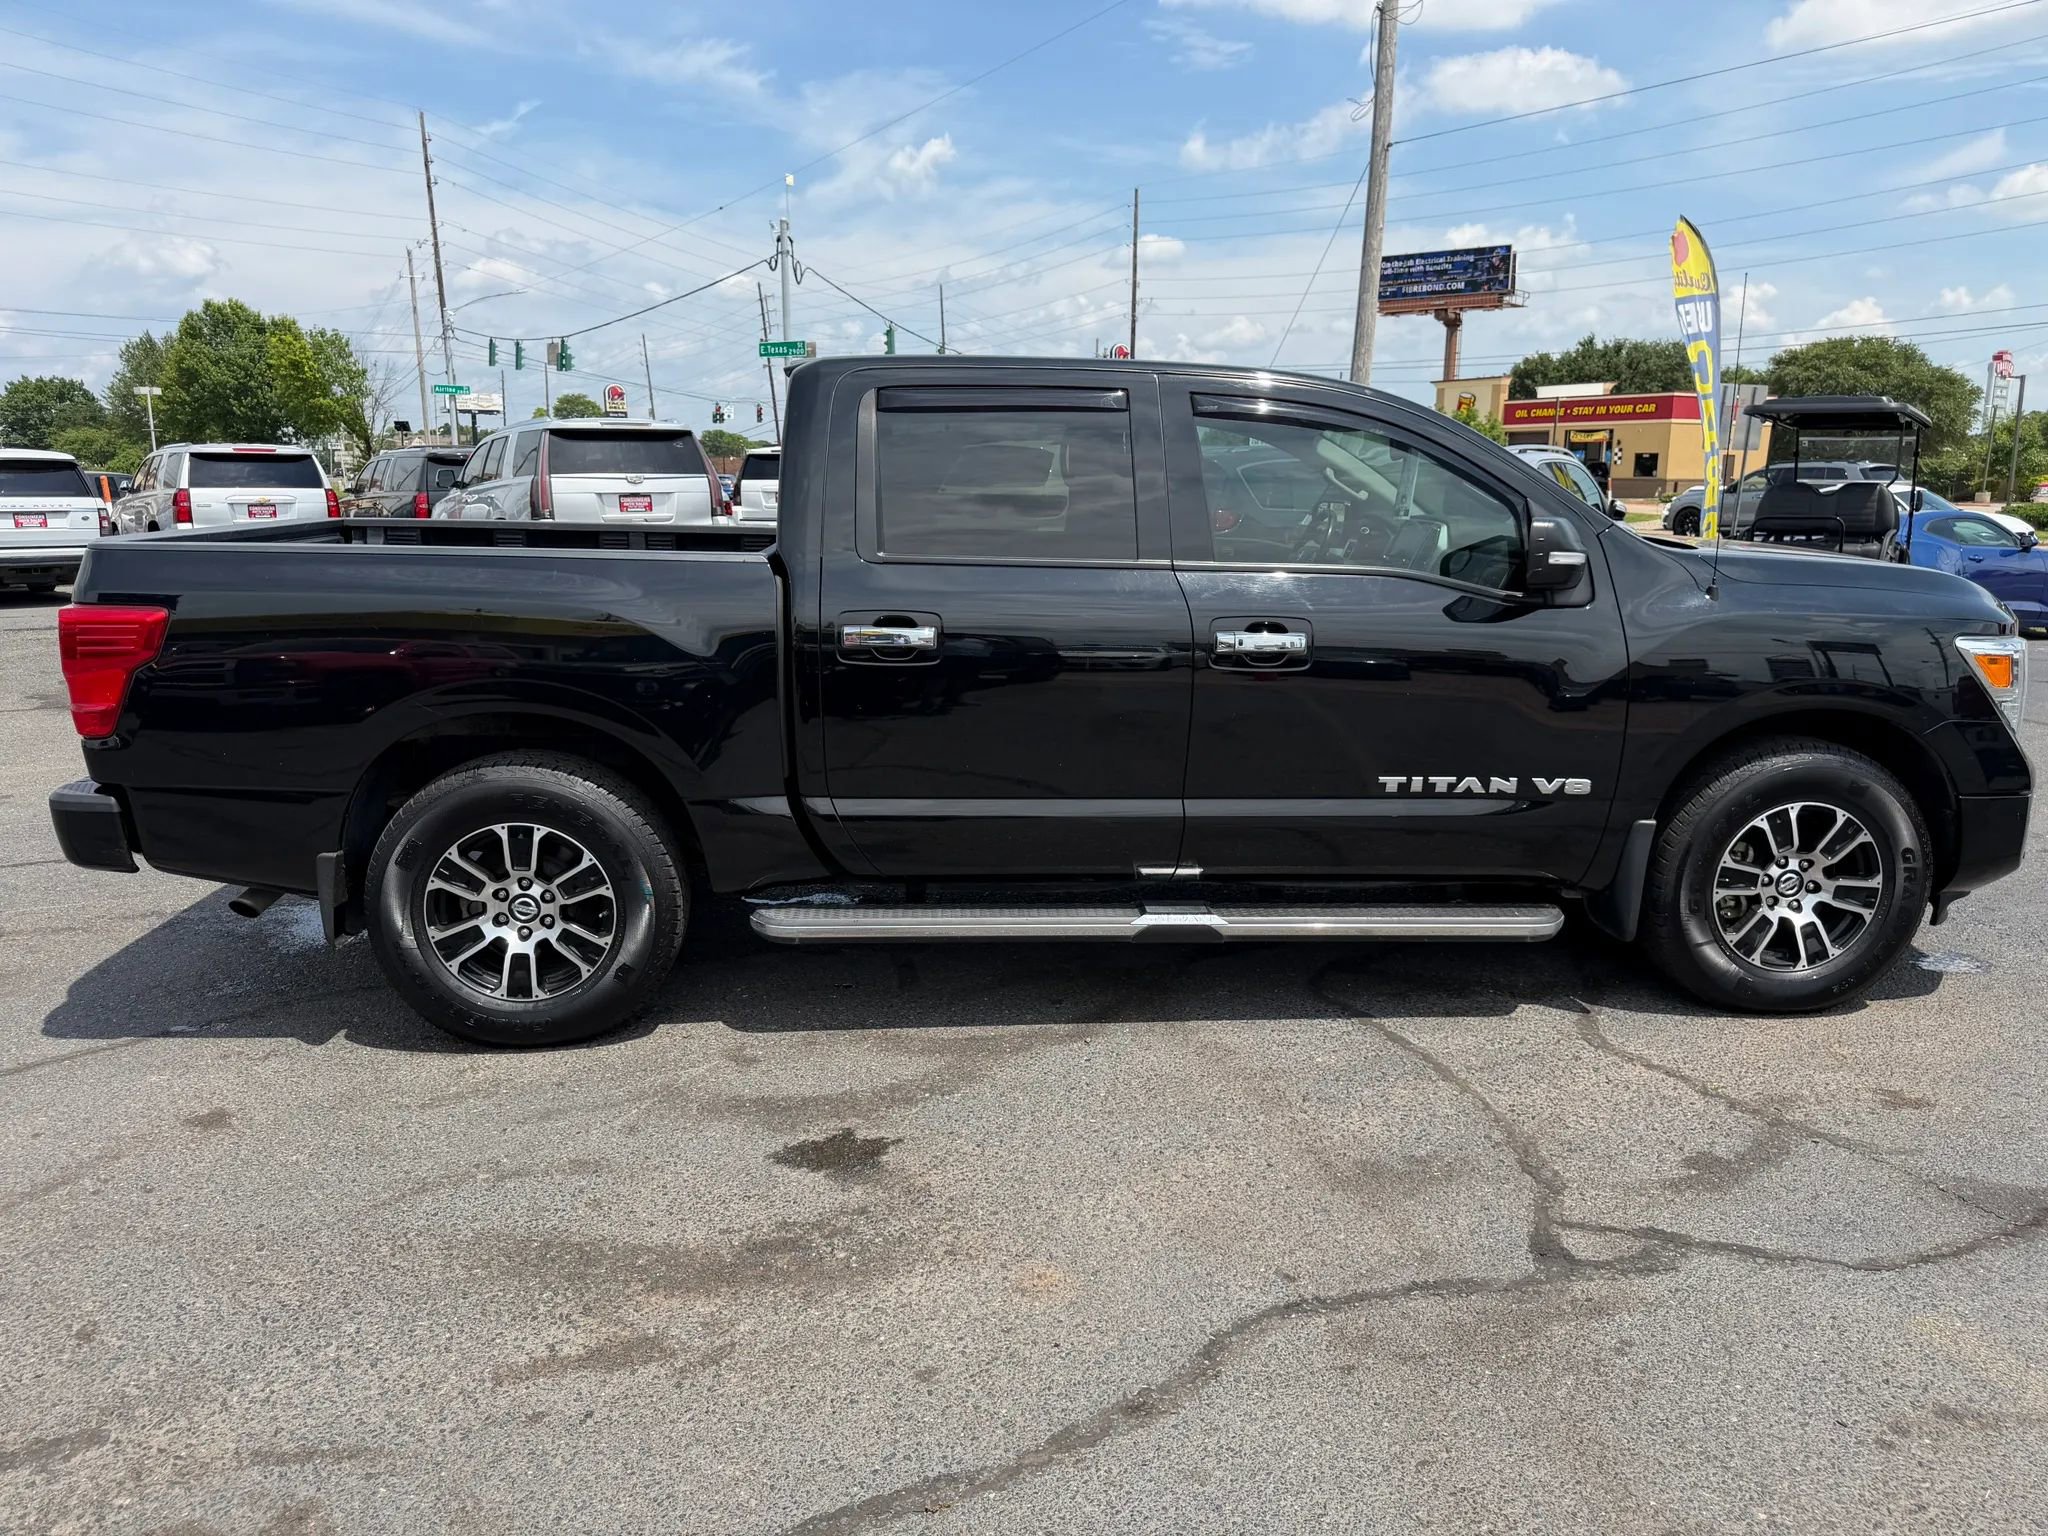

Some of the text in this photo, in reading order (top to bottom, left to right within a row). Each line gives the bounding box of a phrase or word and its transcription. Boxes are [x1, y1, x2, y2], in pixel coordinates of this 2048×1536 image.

[1446, 254, 1475, 263] Training
[1401, 281, 1466, 294] FIBREBOND.COM
[434, 385, 456, 393] Airline
[1515, 409, 1529, 418] OIL
[1572, 406, 1595, 416] STAY
[1596, 405, 1607, 415] IN
[1608, 404, 1634, 414] YOUR
[1635, 403, 1656, 413] CAR
[1377, 776, 1593, 795] TITAN V8
